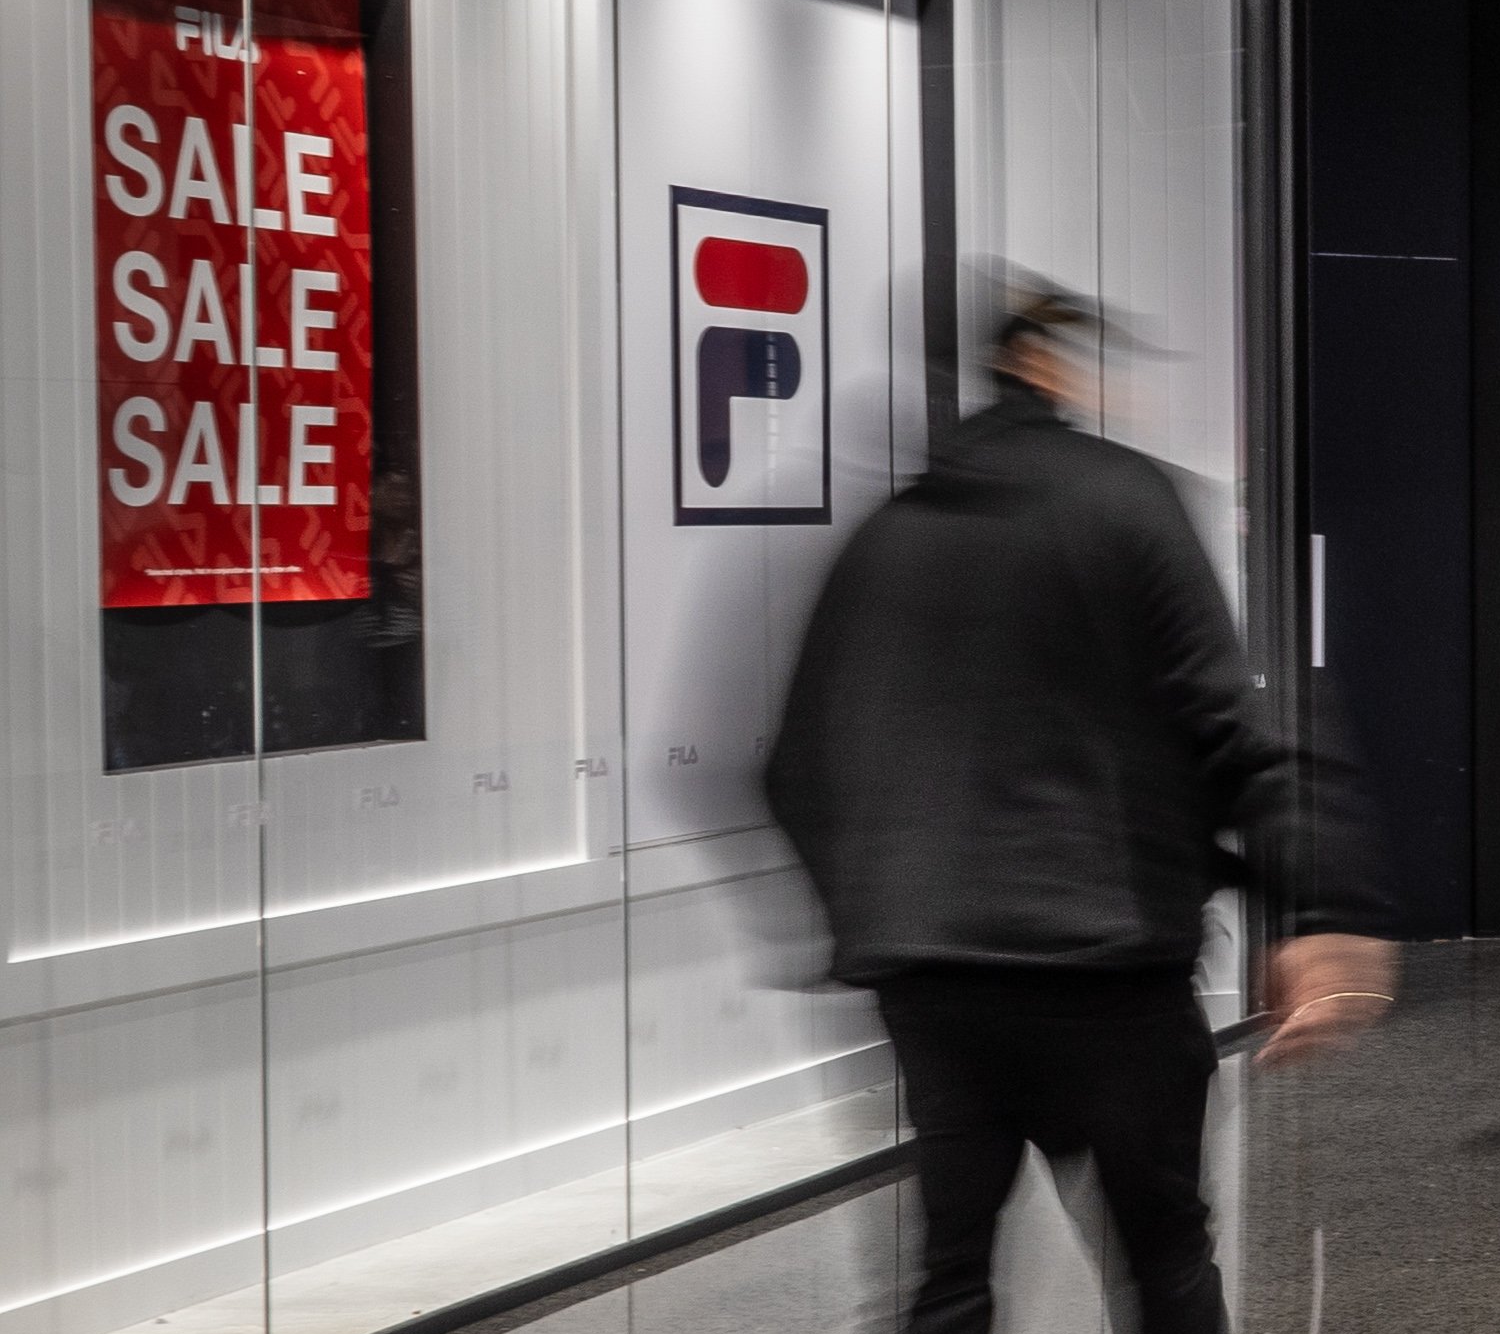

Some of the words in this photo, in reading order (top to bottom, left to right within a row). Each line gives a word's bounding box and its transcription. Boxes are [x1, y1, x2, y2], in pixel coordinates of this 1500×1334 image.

[174, 6, 261, 64] FILA
[104, 104, 340, 237] SALE
[112, 250, 340, 371] SALE
[108, 396, 338, 507] SALE
[472, 771, 509, 795] FILA
[574, 757, 609, 779] FILA
[667, 745, 699, 767] FILA
